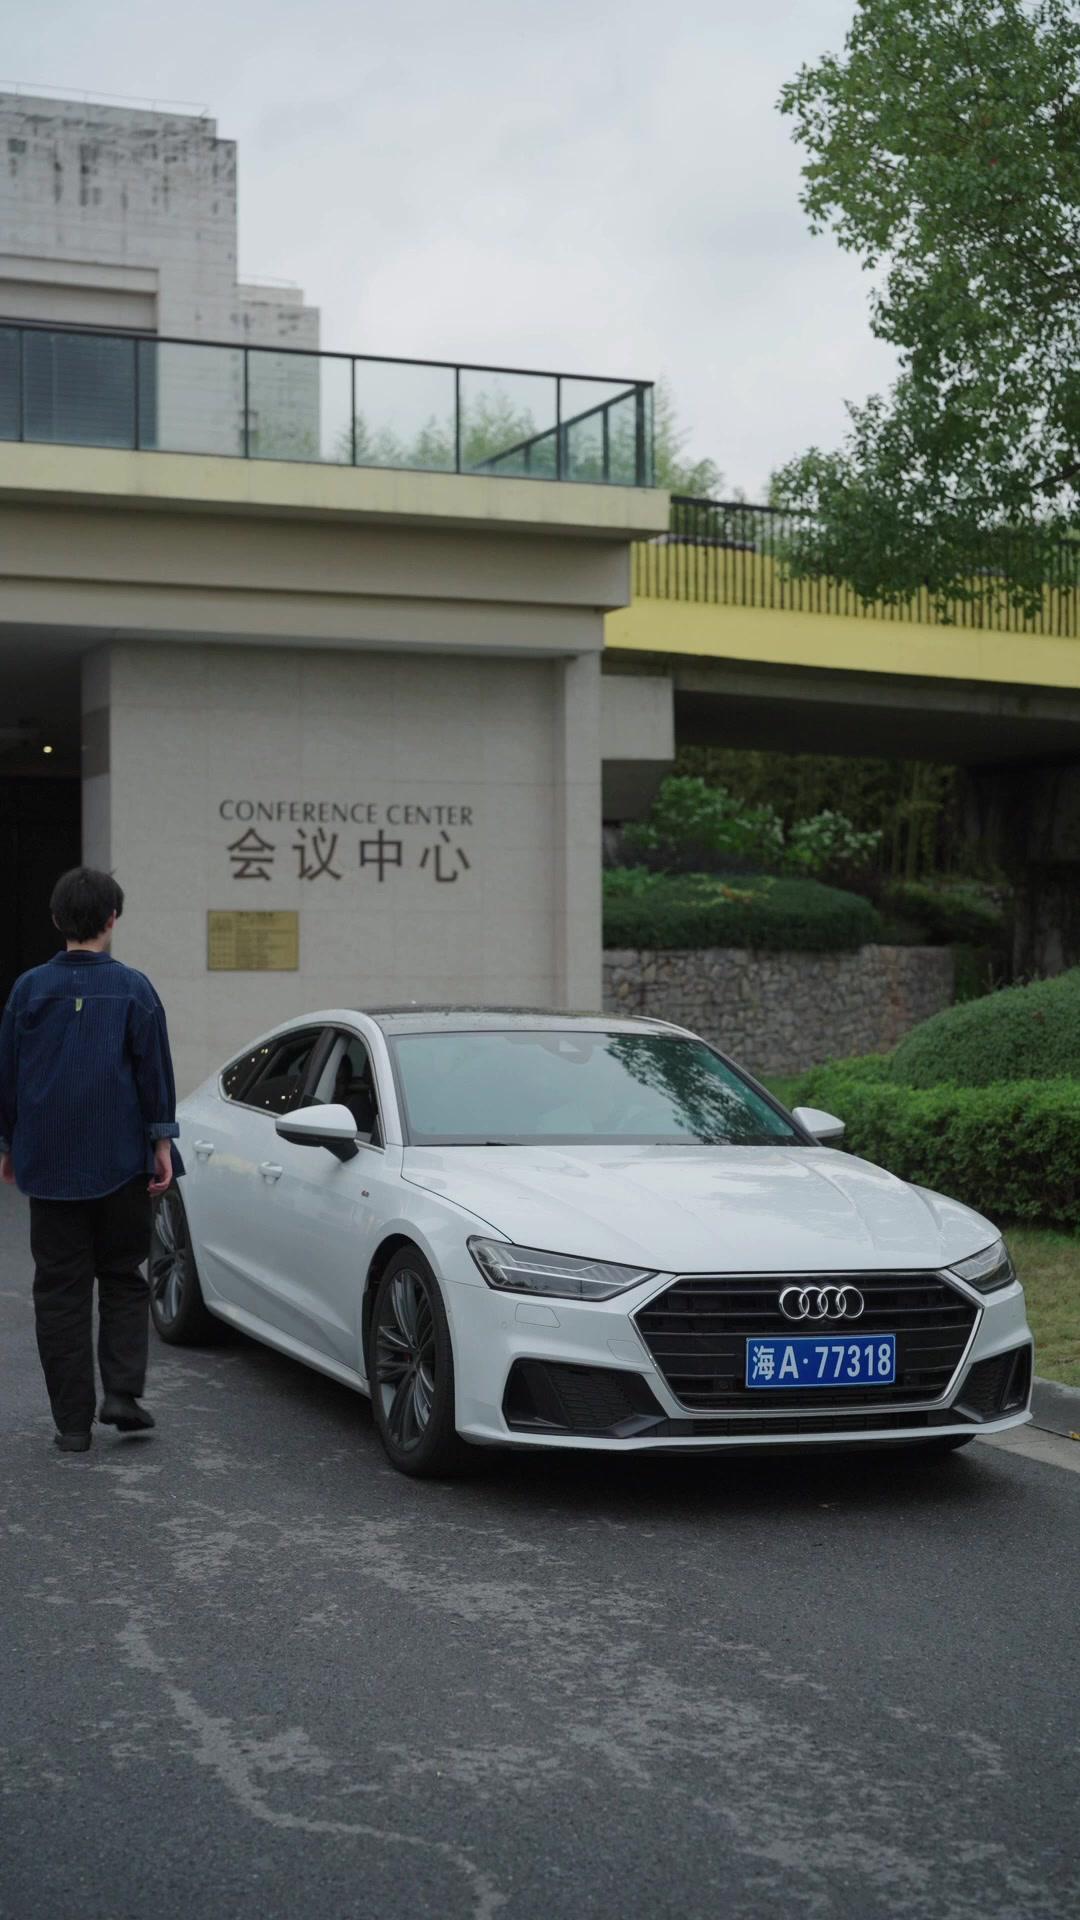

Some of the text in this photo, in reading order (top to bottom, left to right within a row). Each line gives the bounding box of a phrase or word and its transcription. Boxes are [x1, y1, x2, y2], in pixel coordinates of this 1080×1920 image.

[219, 799, 474, 826] CONFERENCE CENTER
[227, 827, 471, 883] 会议中心
